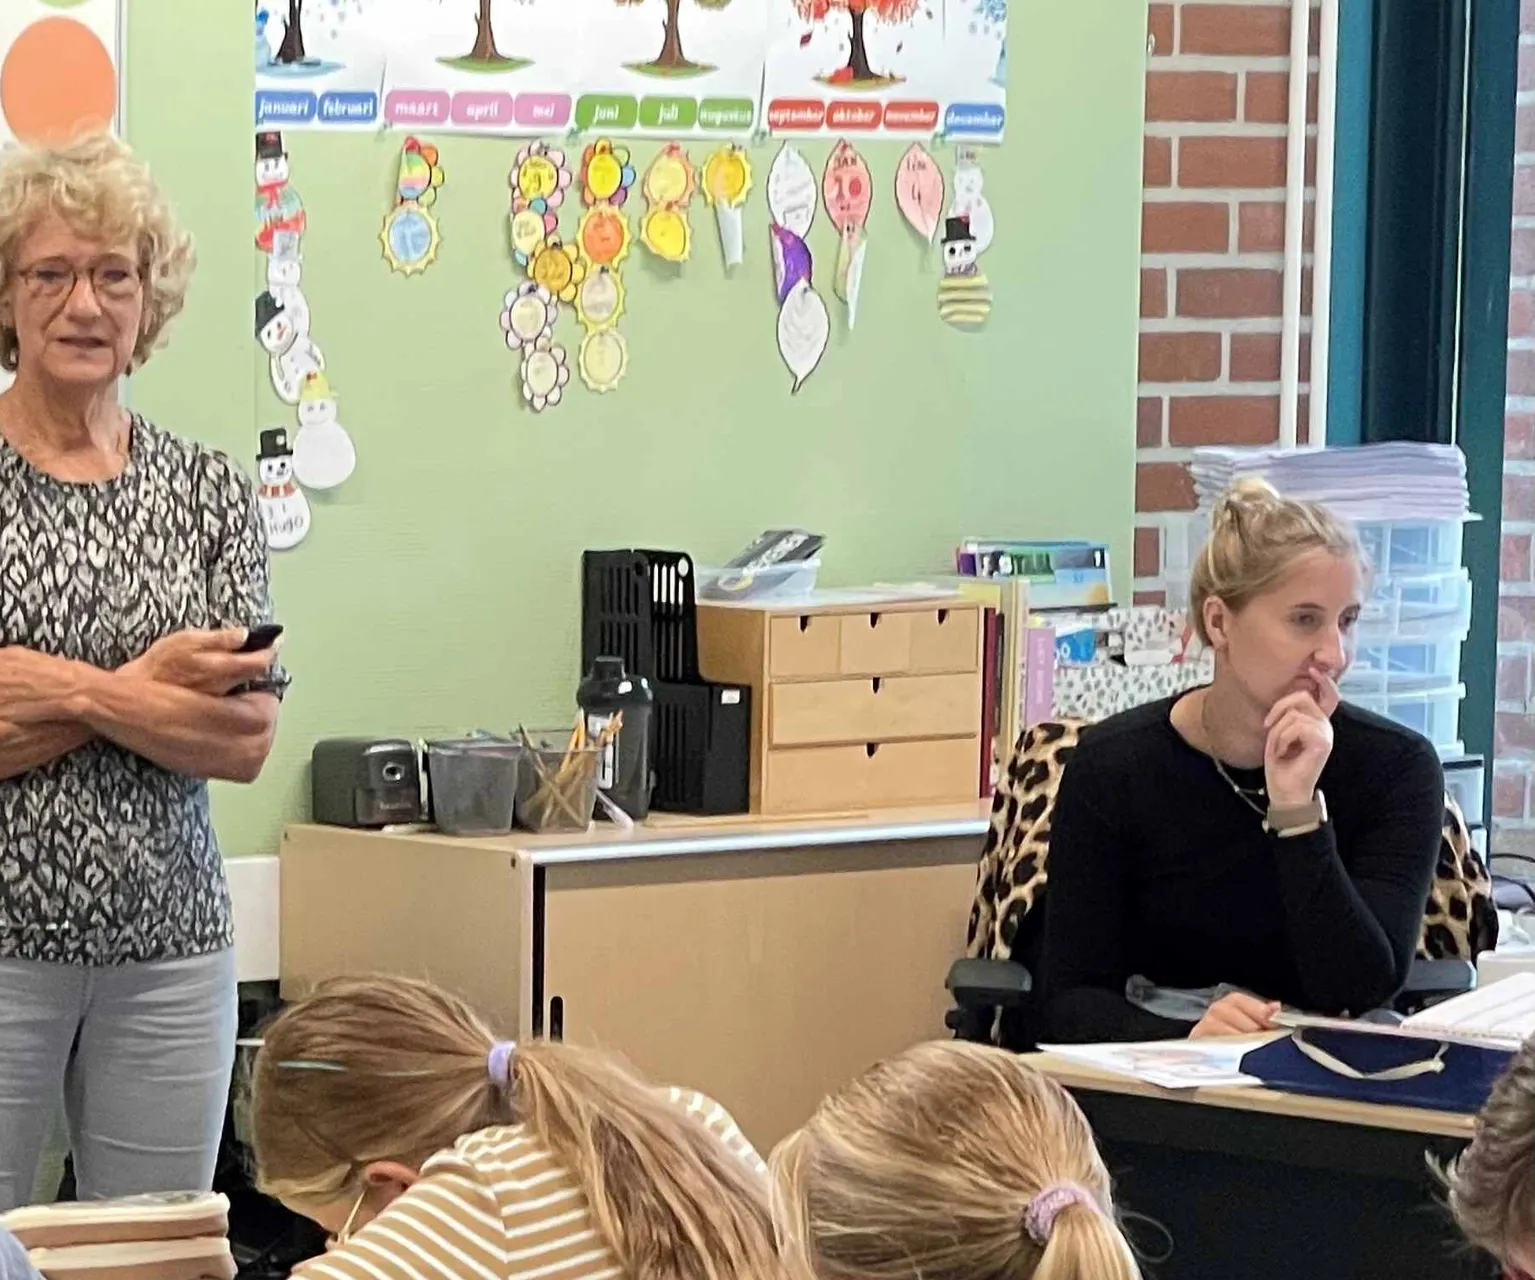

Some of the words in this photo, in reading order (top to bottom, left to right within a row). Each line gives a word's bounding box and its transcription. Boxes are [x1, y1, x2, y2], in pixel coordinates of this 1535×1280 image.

[258, 98, 309, 117] januari
[323, 98, 374, 117] februari
[395, 101, 440, 117] maart
[466, 101, 499, 121] april
[532, 103, 555, 118] mei
[593, 104, 619, 124] juni
[658, 103, 679, 124] juli
[700, 106, 752, 126] augustus
[769, 108, 824, 126] september
[833, 108, 875, 123] oktober
[885, 108, 937, 123] november
[946, 109, 1002, 127] december
